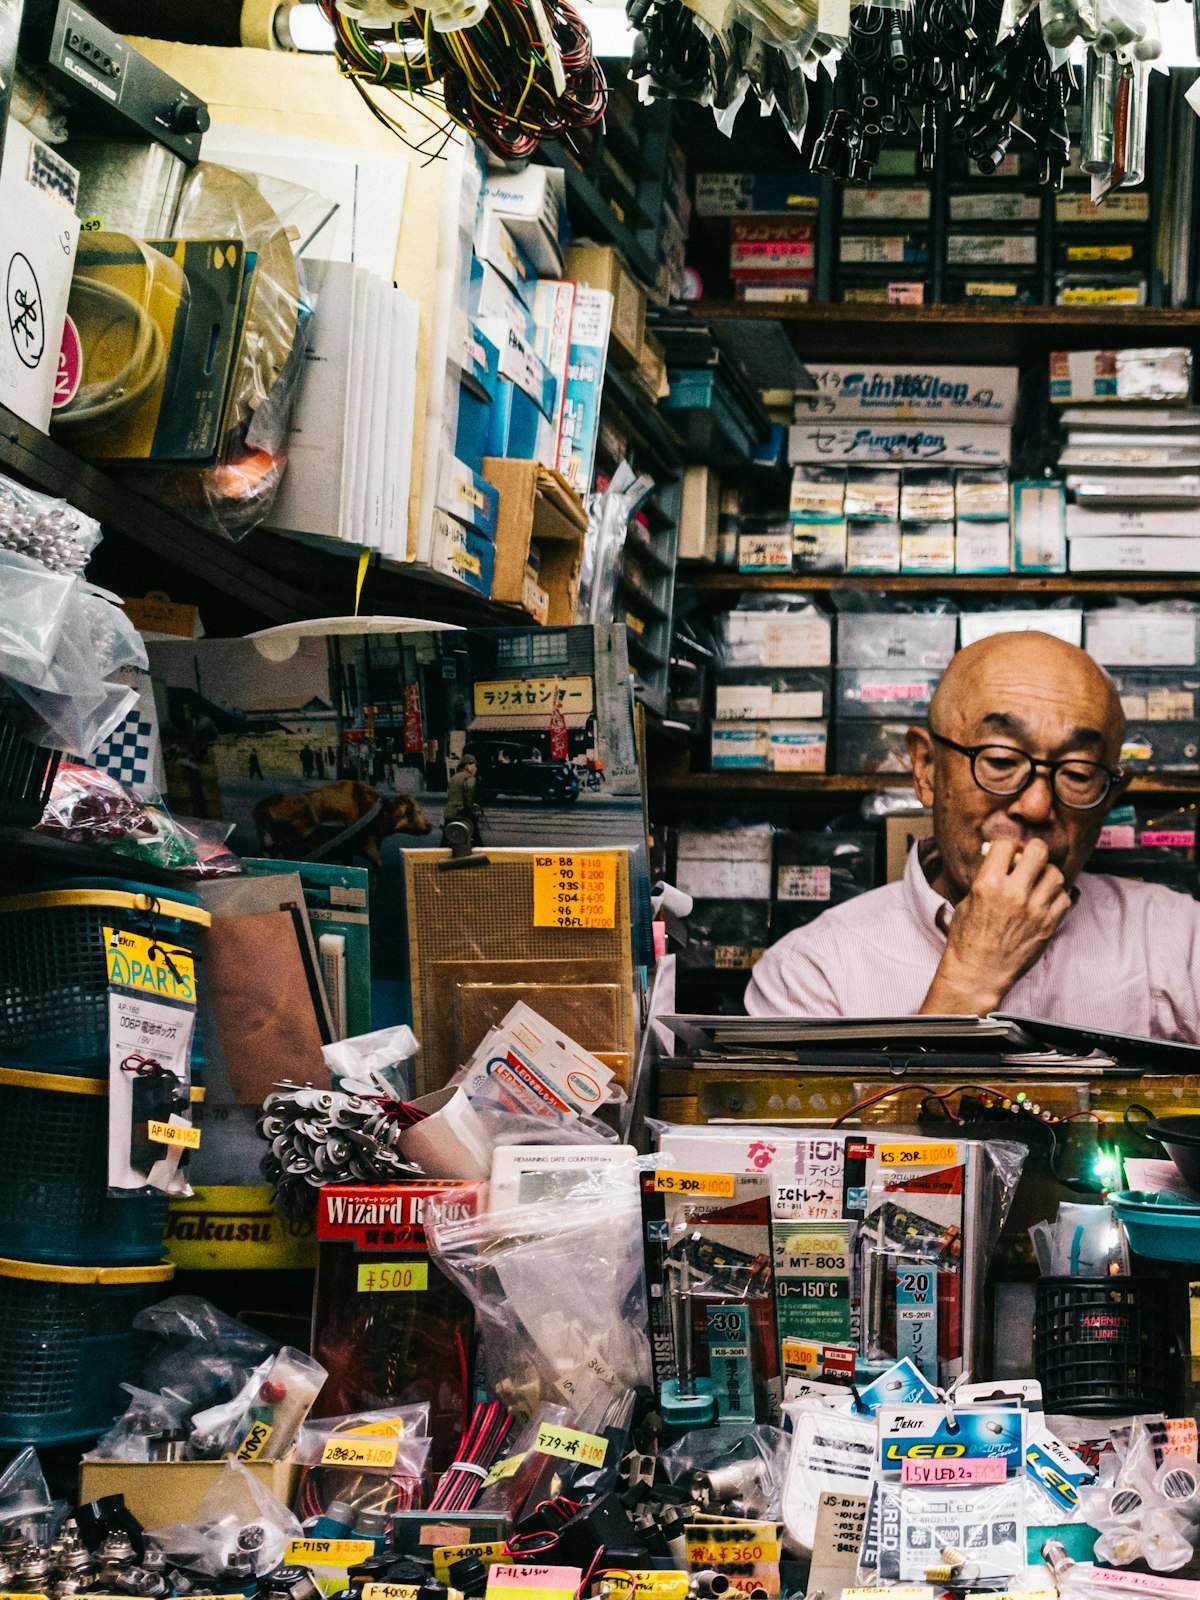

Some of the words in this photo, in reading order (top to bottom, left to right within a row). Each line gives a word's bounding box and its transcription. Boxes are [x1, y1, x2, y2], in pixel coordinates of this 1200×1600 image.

[880, 1151, 921, 1163] KS-20R
[656, 1176, 700, 1192] KS-30R
[777, 1187, 834, 1202] ICトレーナー
[326, 1196, 402, 1225] Wizard
[789, 1256, 846, 1270] MT-803
[365, 1268, 413, 1291] ¥500
[903, 1273, 929, 1292] 20
[713, 1312, 742, 1331] 30
[902, 1311, 932, 1319] KS-20R
[654, 1331, 672, 1362] USE
[714, 1348, 746, 1356] KS-30R
[785, 1351, 813, 1364] ¥300
[886, 1443, 966, 1460] LED
[883, 1510, 899, 1552] RED
[910, 1530, 928, 1546] 赤
[291, 1541, 331, 1553] F-7159
[719, 1546, 763, 1560] ¥360
